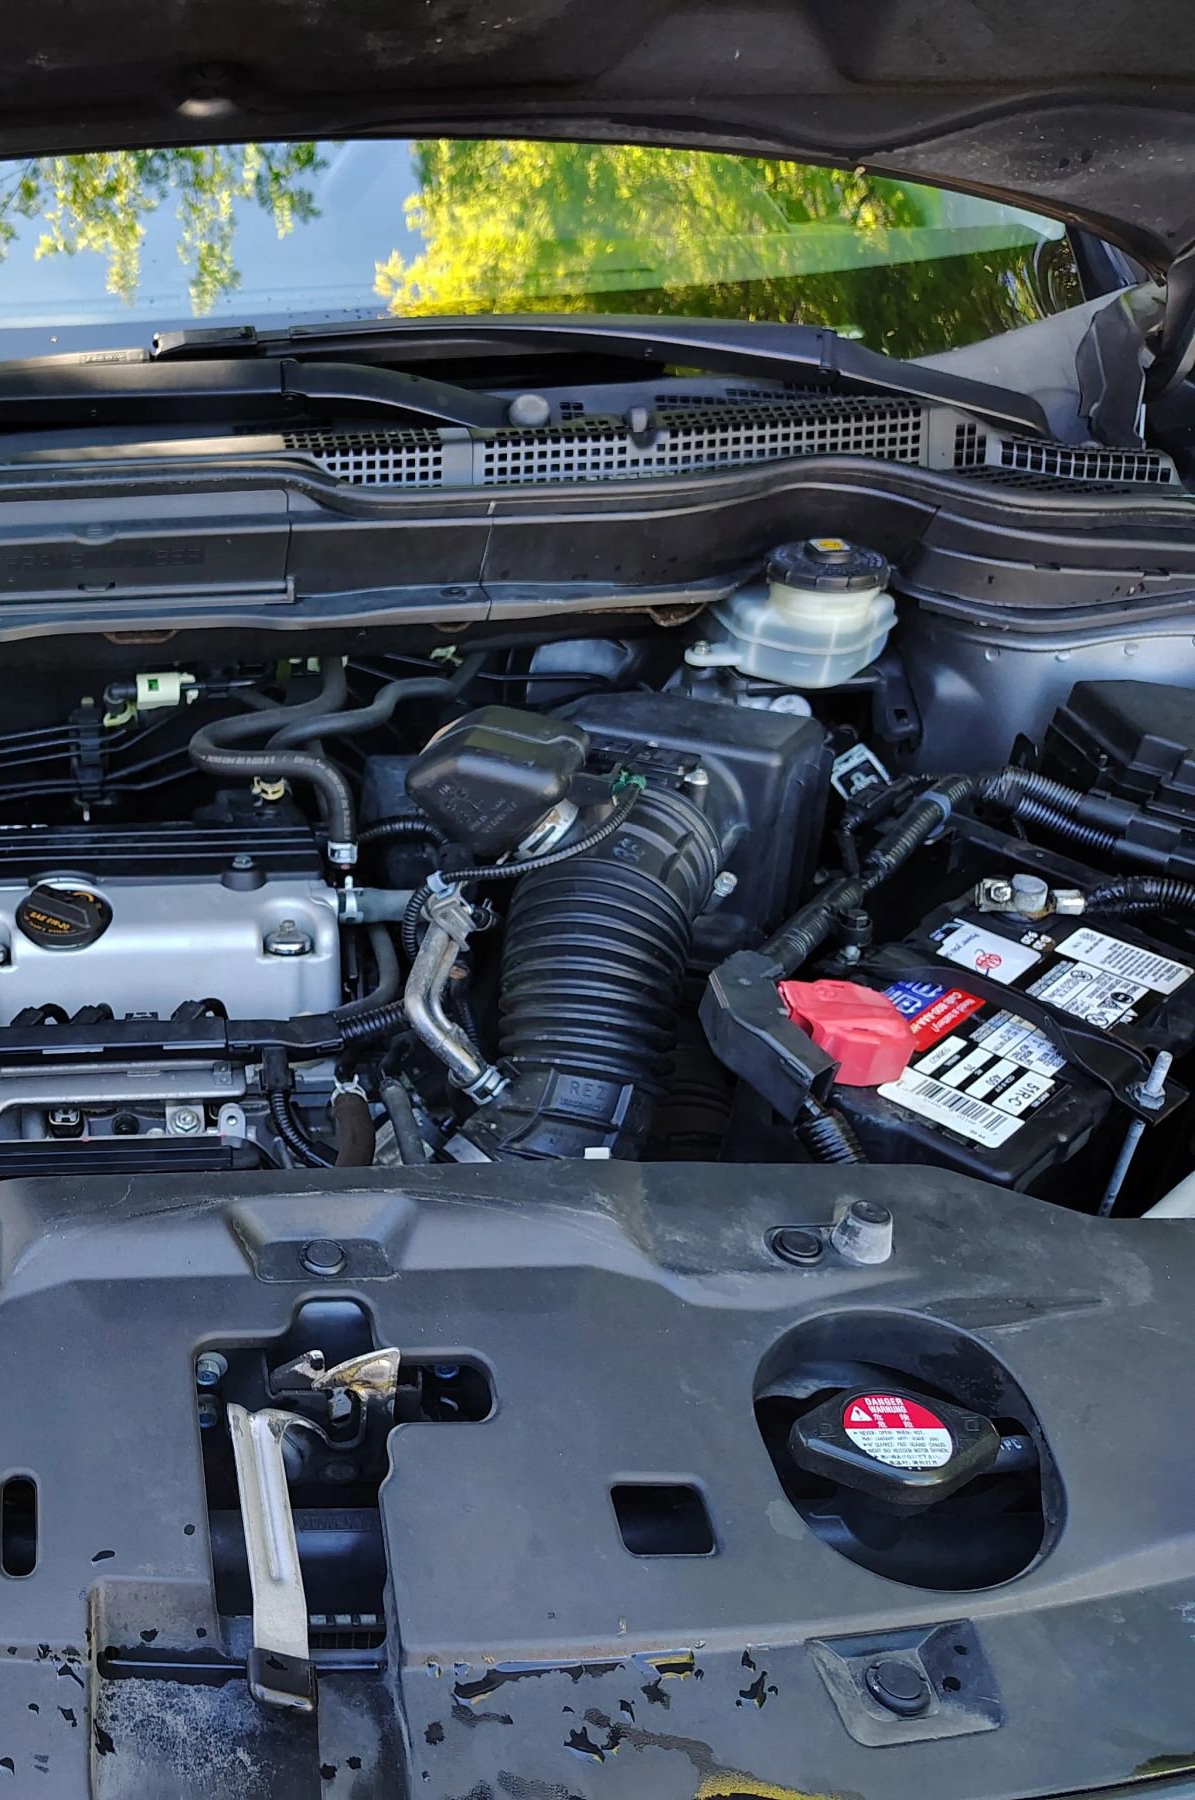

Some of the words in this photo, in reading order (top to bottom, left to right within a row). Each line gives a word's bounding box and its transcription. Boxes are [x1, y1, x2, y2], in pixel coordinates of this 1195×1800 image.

[1008, 1083, 1040, 1106] 51R-C
[864, 1397, 904, 1406] DANGER
[868, 1405, 908, 1414] WARNUNG
